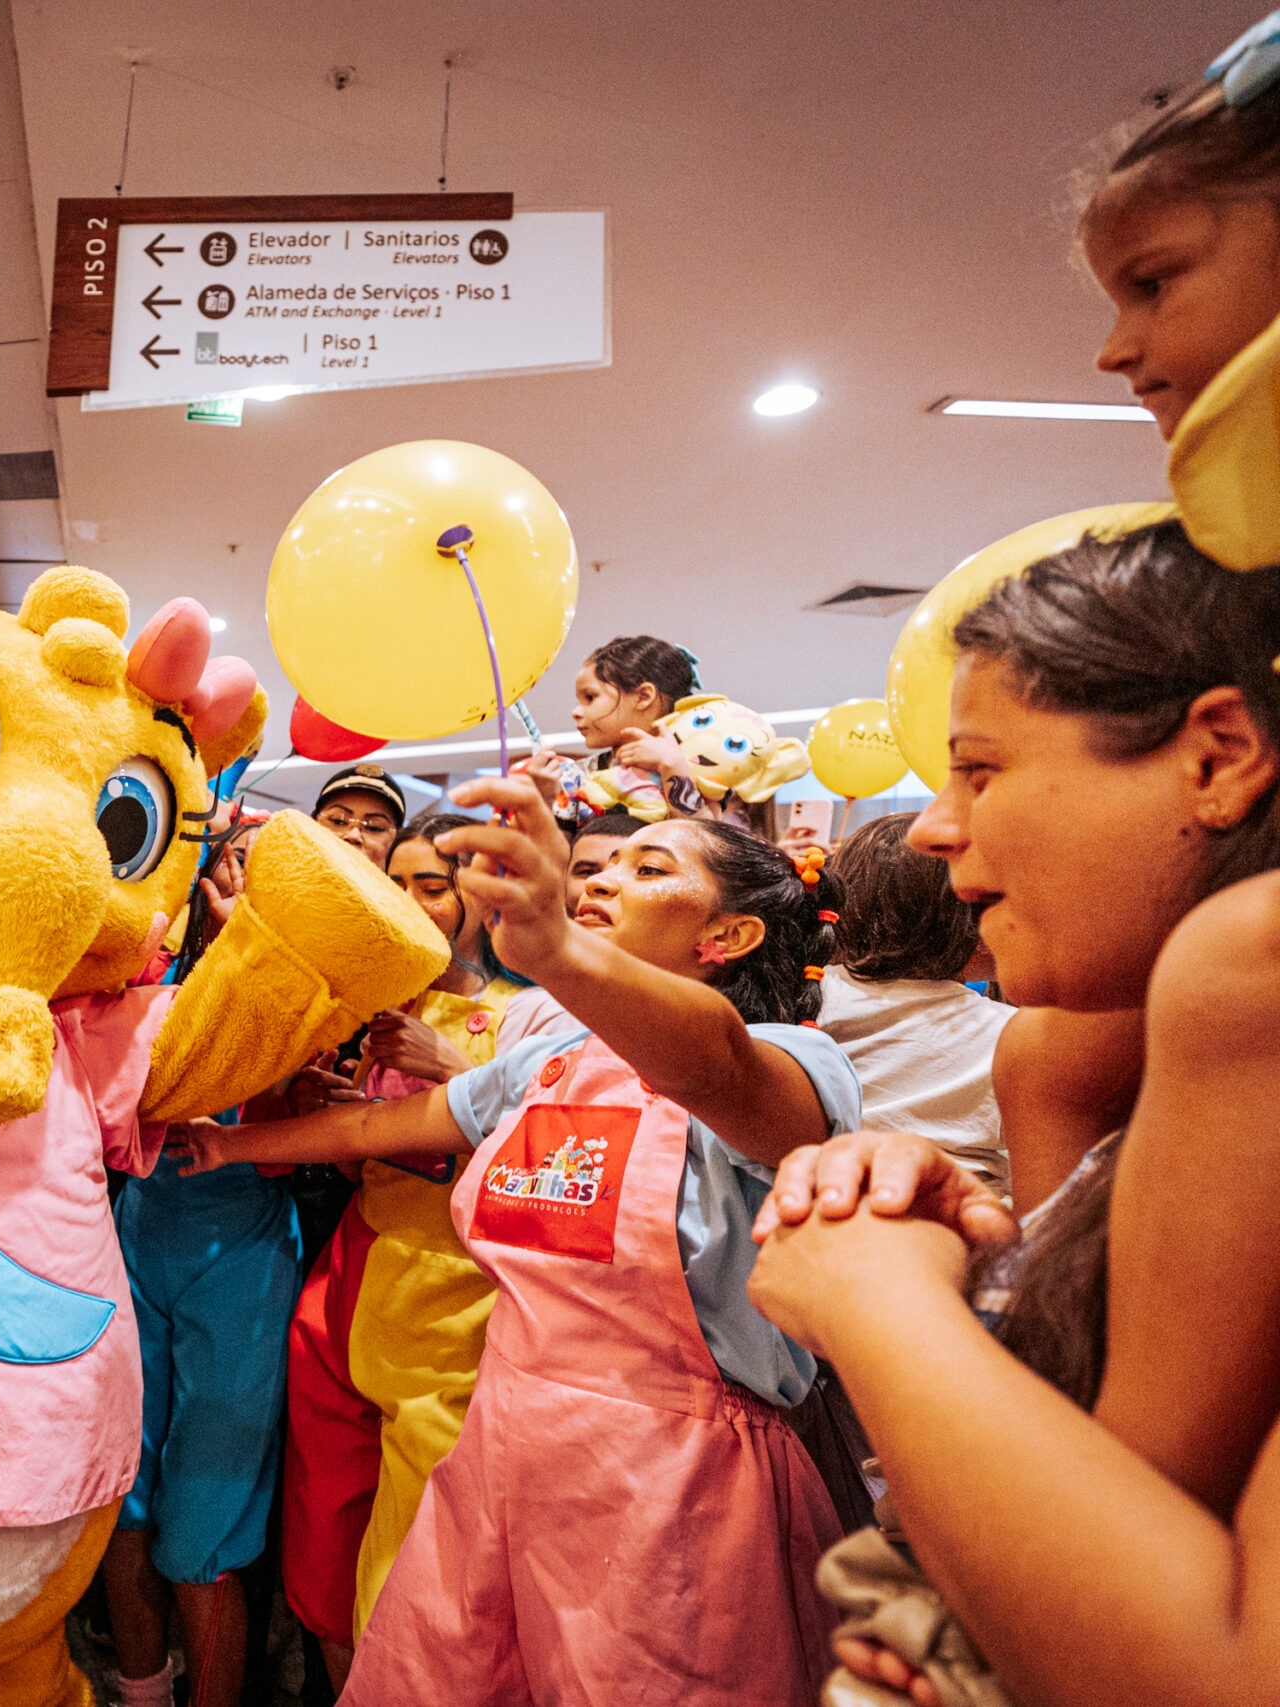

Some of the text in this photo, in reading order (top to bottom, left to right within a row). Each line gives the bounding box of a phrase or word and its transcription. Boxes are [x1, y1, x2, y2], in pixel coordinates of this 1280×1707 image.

[249, 230, 460, 248] Elevador Sanitarios
[83, 217, 108, 296] PISO 2
[247, 252, 460, 265] Elevators Elevators
[246, 283, 511, 303] Alameda de Serviços Piso 1
[245, 305, 443, 320] ATM and Exchange Level 1
[322, 334, 378, 350] Piso 1
[219, 353, 289, 367] bodytech
[321, 355, 370, 368] Level 1
[488, 1165, 596, 1206] Maravilhas
